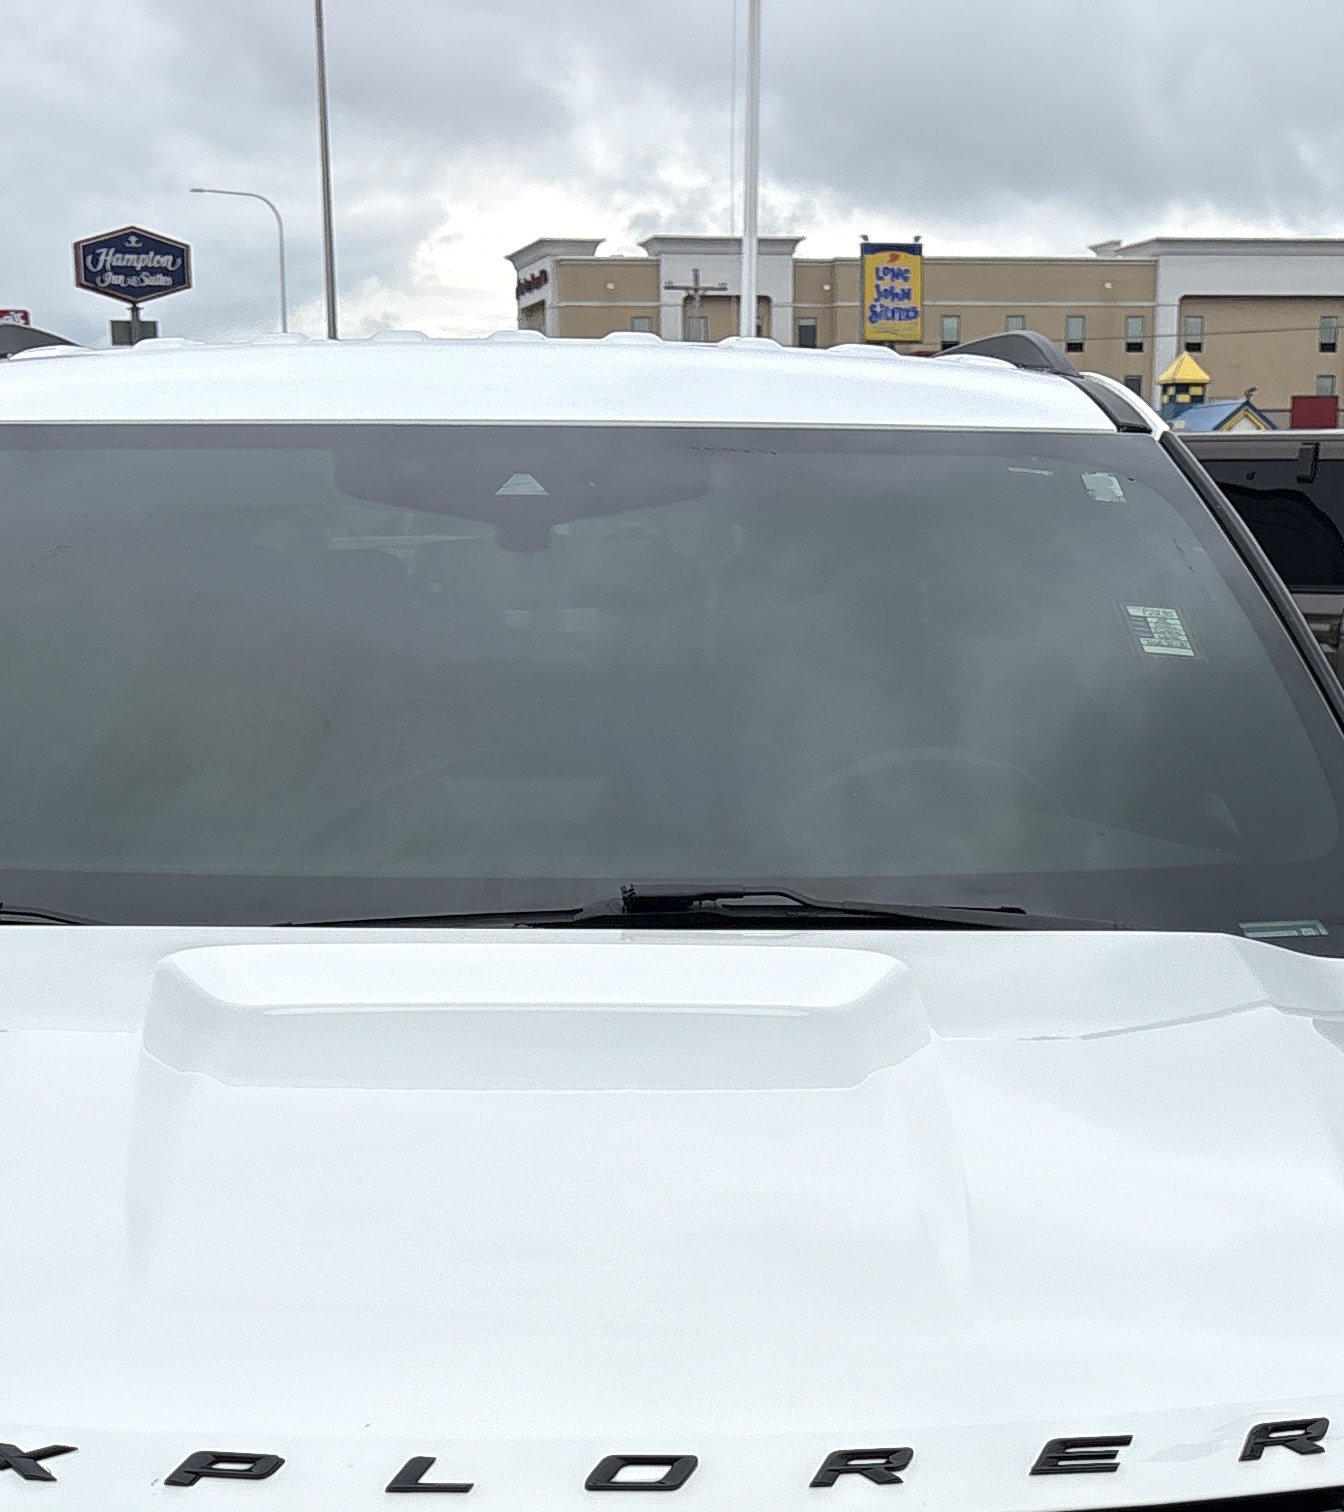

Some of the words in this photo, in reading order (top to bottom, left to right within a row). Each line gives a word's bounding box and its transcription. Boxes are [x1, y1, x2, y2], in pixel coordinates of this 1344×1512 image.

[86, 247, 182, 272] Hampton
[96, 271, 129, 287] Inn
[138, 271, 173, 287] Suites
